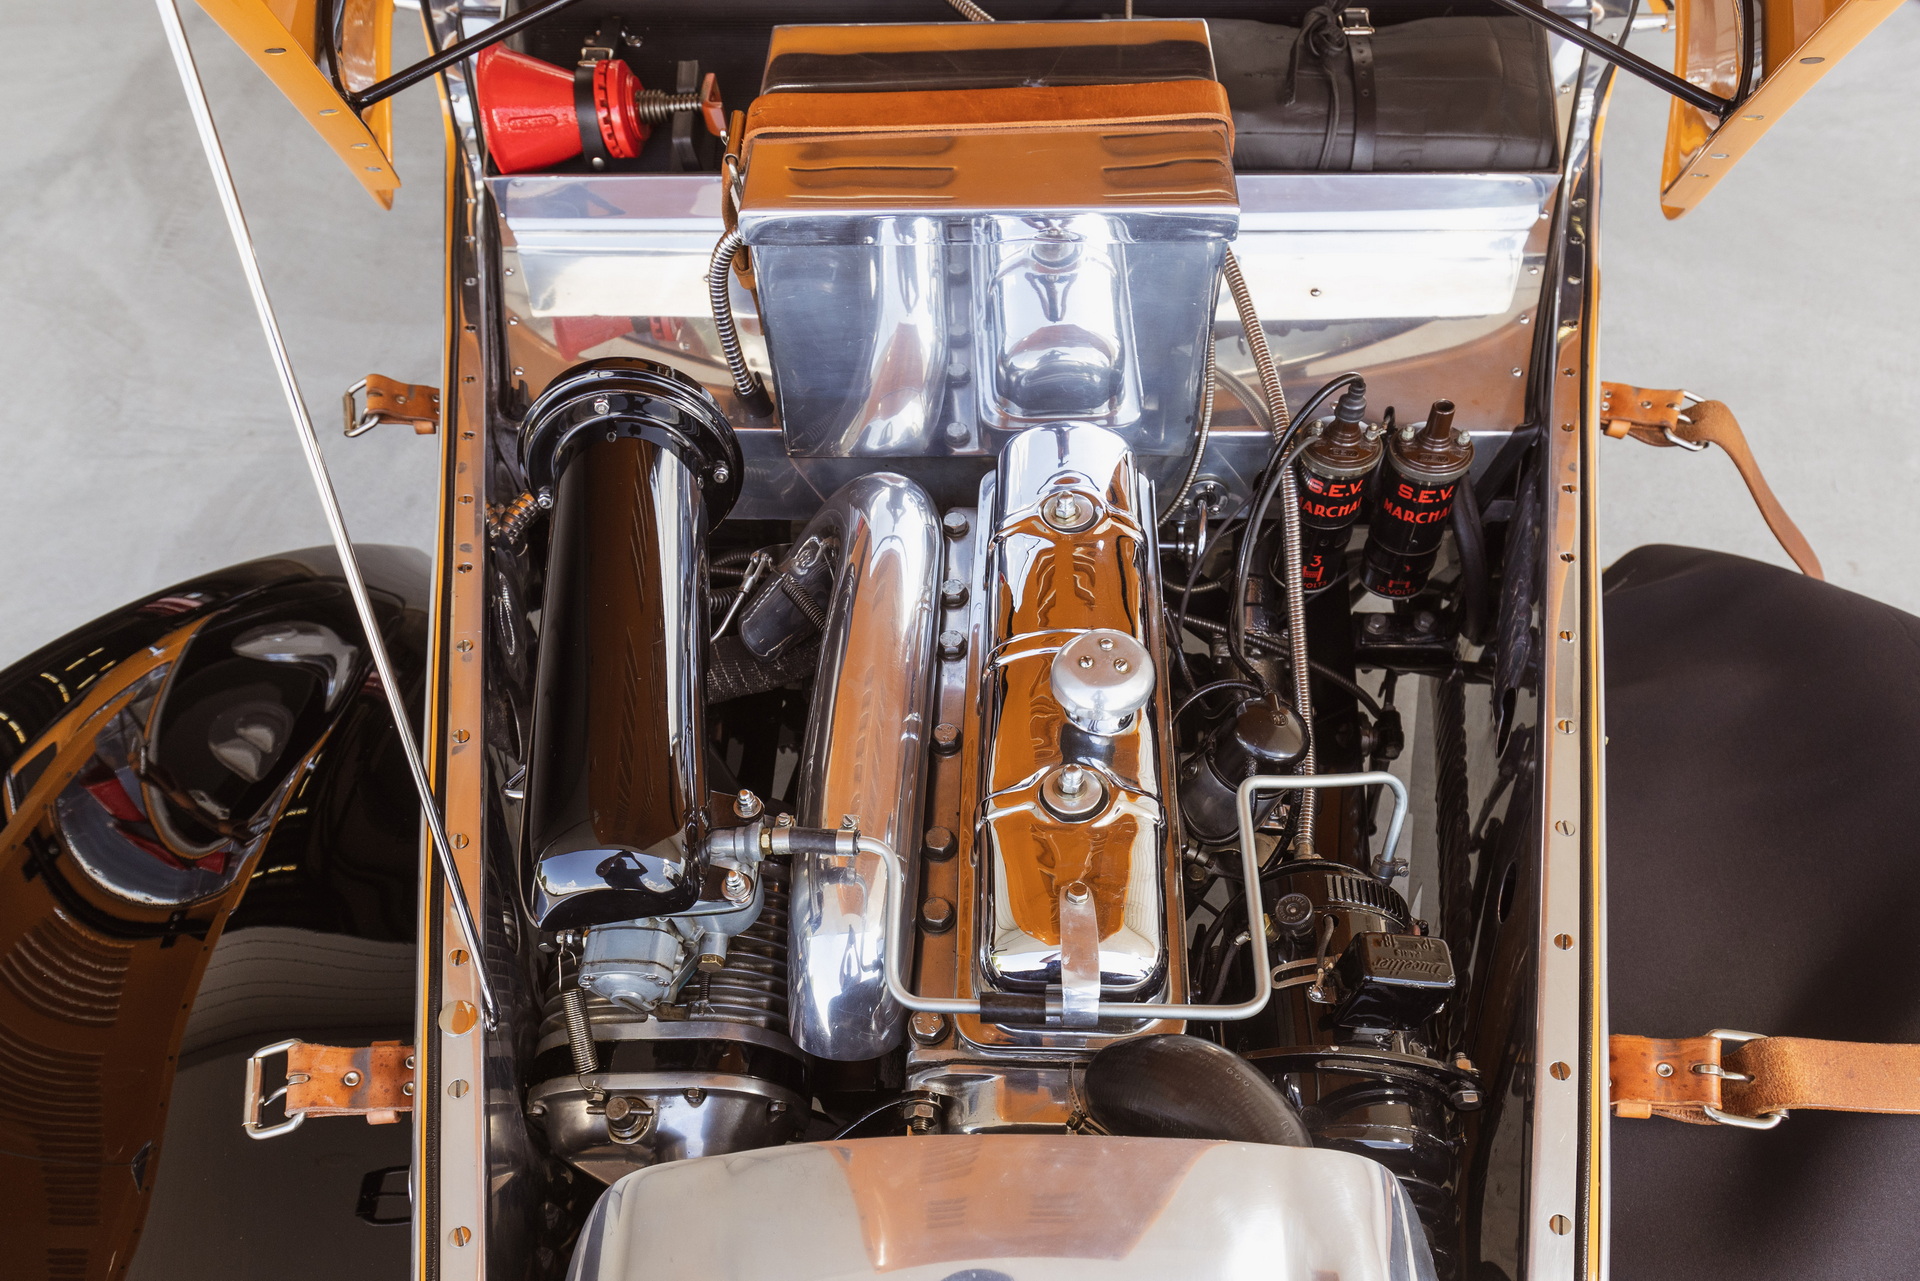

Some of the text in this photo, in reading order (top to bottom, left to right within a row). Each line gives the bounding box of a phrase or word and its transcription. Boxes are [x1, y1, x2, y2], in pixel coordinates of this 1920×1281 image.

[1308, 478, 1364, 498] S.E.V.
[1397, 483, 1455, 504] S.E.V.
[1309, 555, 1323, 567] 3
[1387, 586, 1417, 596] VOLTS
